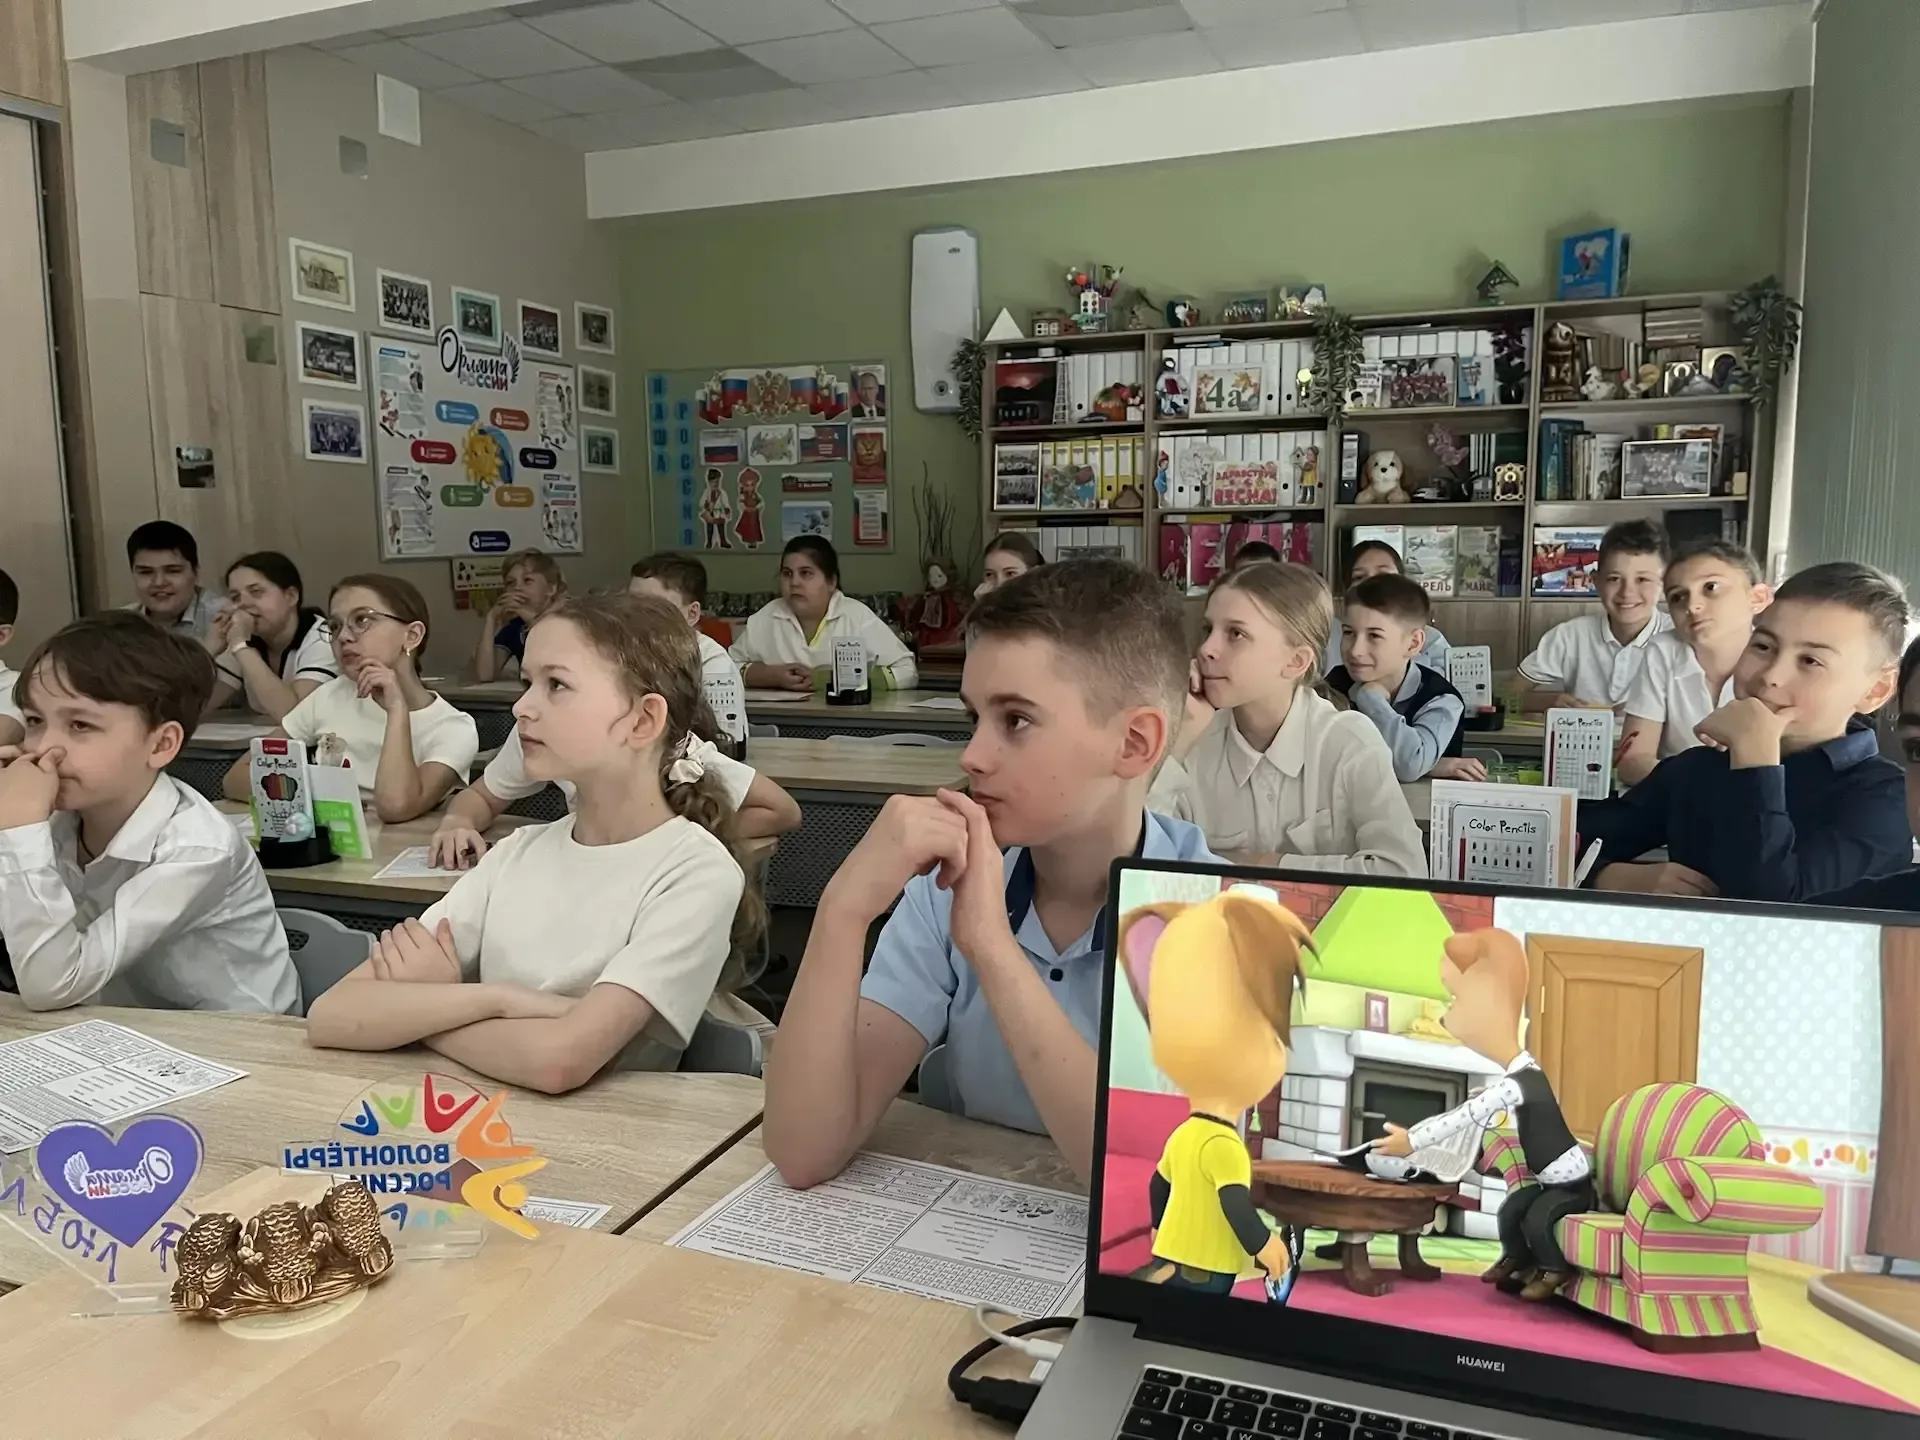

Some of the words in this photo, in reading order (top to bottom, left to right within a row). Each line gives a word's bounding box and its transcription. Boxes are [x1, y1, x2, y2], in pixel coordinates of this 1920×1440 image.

[440, 328, 508, 378] Орлята
[460, 371, 508, 391] РОССИИ
[1421, 581, 1452, 592] РЕЛЬ
[1469, 818, 1496, 832] Color
[1500, 820, 1536, 834] Pencils
[1457, 1355, 1504, 1372] HUAWEI
[1193, 1423, 1204, 1433] Q
